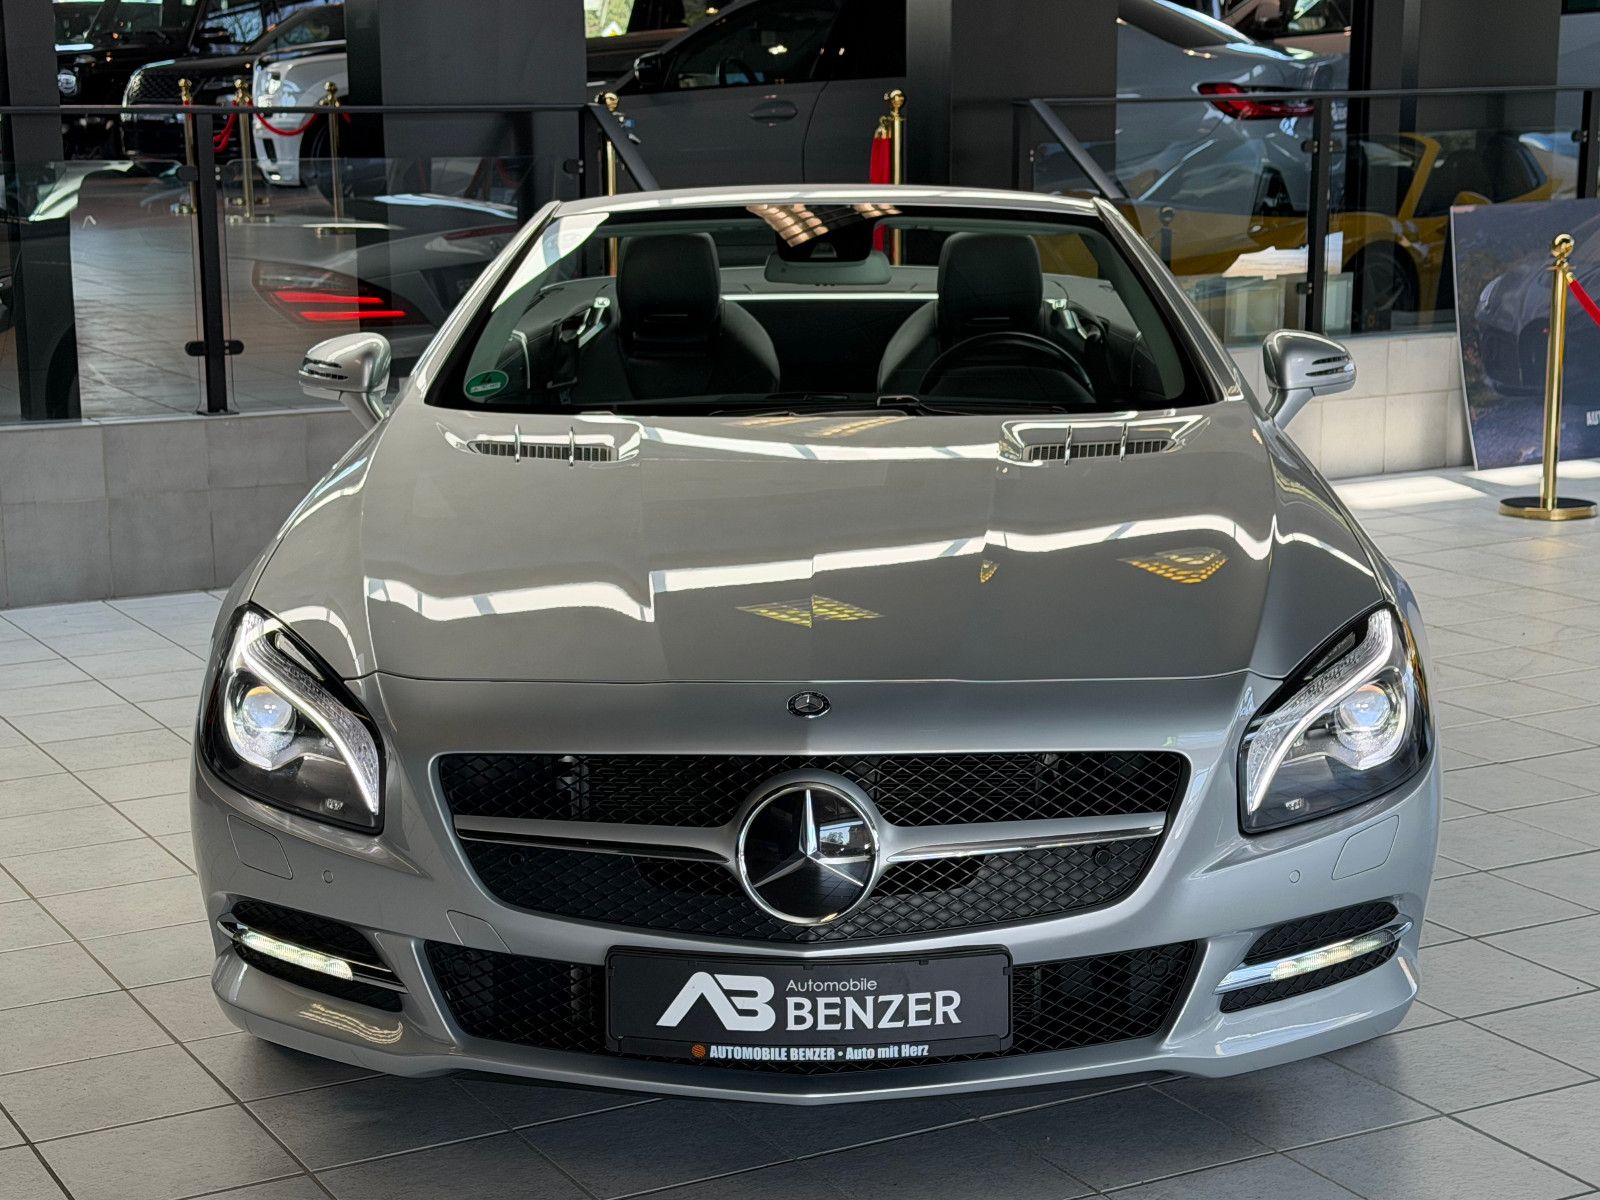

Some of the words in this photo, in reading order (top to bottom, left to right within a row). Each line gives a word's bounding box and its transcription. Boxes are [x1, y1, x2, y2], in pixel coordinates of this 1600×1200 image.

[785, 978, 878, 992] Automobile
[785, 990, 962, 1031] BENZER
[709, 1045, 787, 1060] AUTOMOBILE
[790, 1047, 836, 1061] BENZER
[845, 1047, 875, 1060] Auto
[877, 1046, 900, 1059] mit
[901, 1044, 929, 1057] Herz
